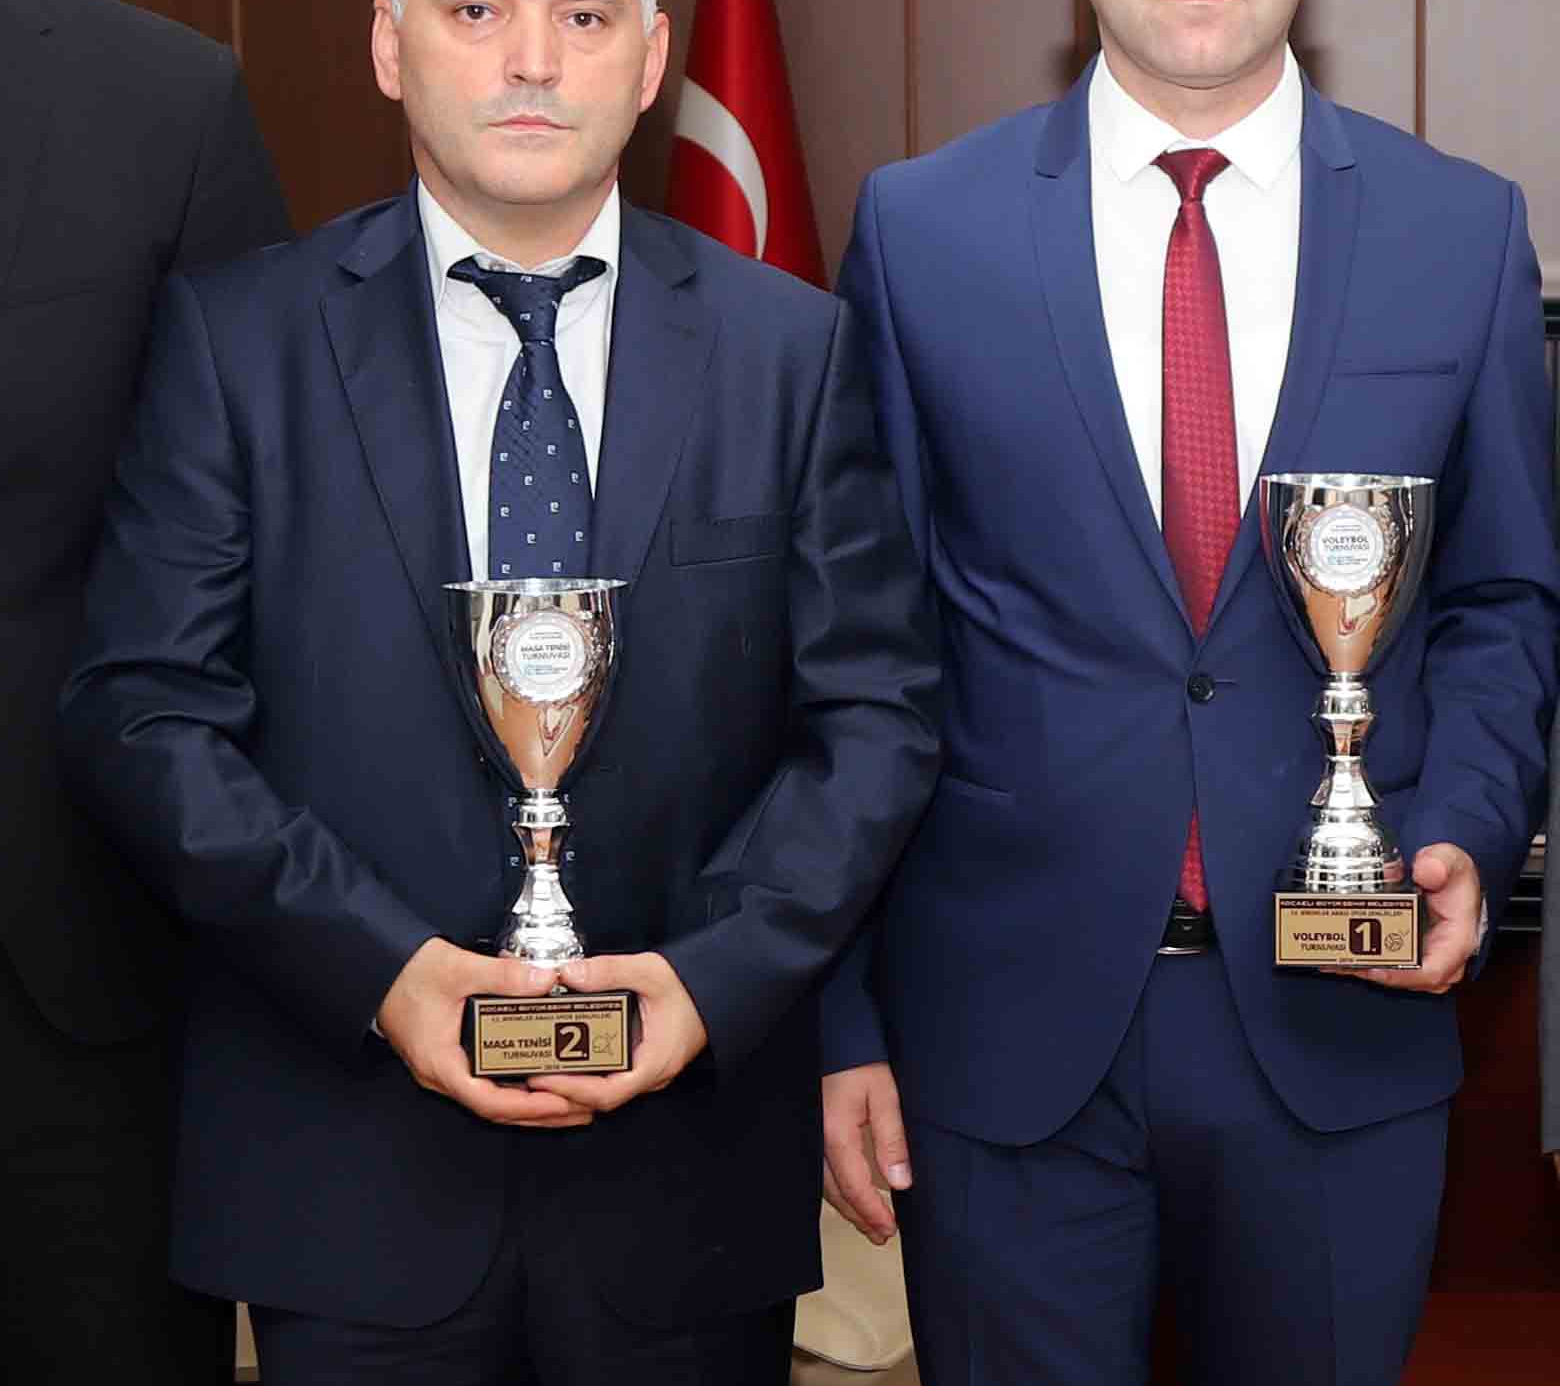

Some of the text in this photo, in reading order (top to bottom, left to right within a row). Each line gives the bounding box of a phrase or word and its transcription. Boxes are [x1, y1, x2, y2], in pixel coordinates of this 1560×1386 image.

[1322, 534, 1369, 544] VOLEYBOL
[520, 644, 544, 652] MASA
[1293, 932, 1346, 942] VOLEYBOL
[483, 1036, 552, 1050] MASA TENİSİ
[559, 1025, 588, 1058] 2.
[503, 1050, 552, 1061] TURNUVASI
